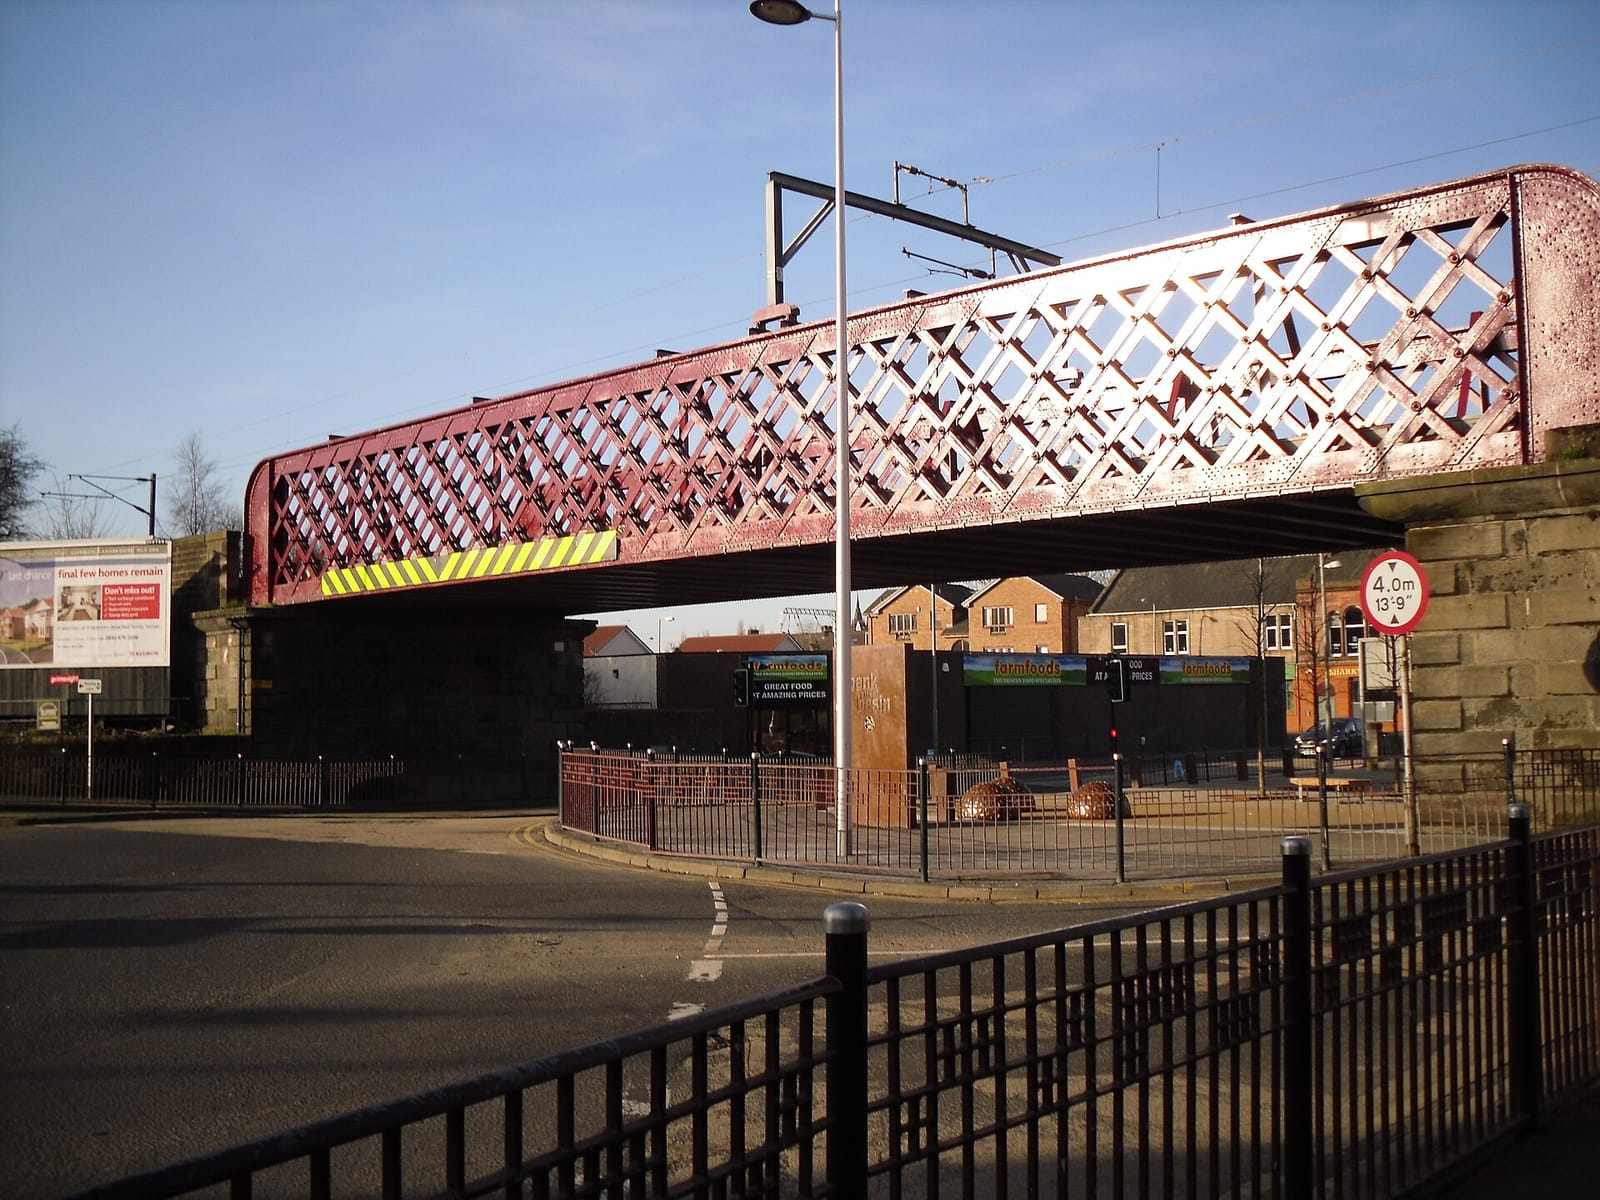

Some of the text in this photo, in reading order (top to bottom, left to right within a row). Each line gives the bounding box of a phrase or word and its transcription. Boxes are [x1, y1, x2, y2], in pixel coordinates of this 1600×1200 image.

[58, 566, 163, 579] final few homes remain
[1373, 576, 1415, 593] 4.0m
[104, 585, 155, 595] Don't miss out!
[753, 660, 824, 671] frmfoods
[994, 659, 1061, 676] farmfoods
[1128, 659, 1143, 669] OOD
[1182, 661, 1233, 676] farmfoods
[1095, 671, 1103, 681] AT
[1131, 671, 1153, 681] PRICES
[1328, 667, 1358, 676] SHARK
[791, 682, 812, 690] FOOD
[753, 690, 826, 699] T AMAZING PRICES
